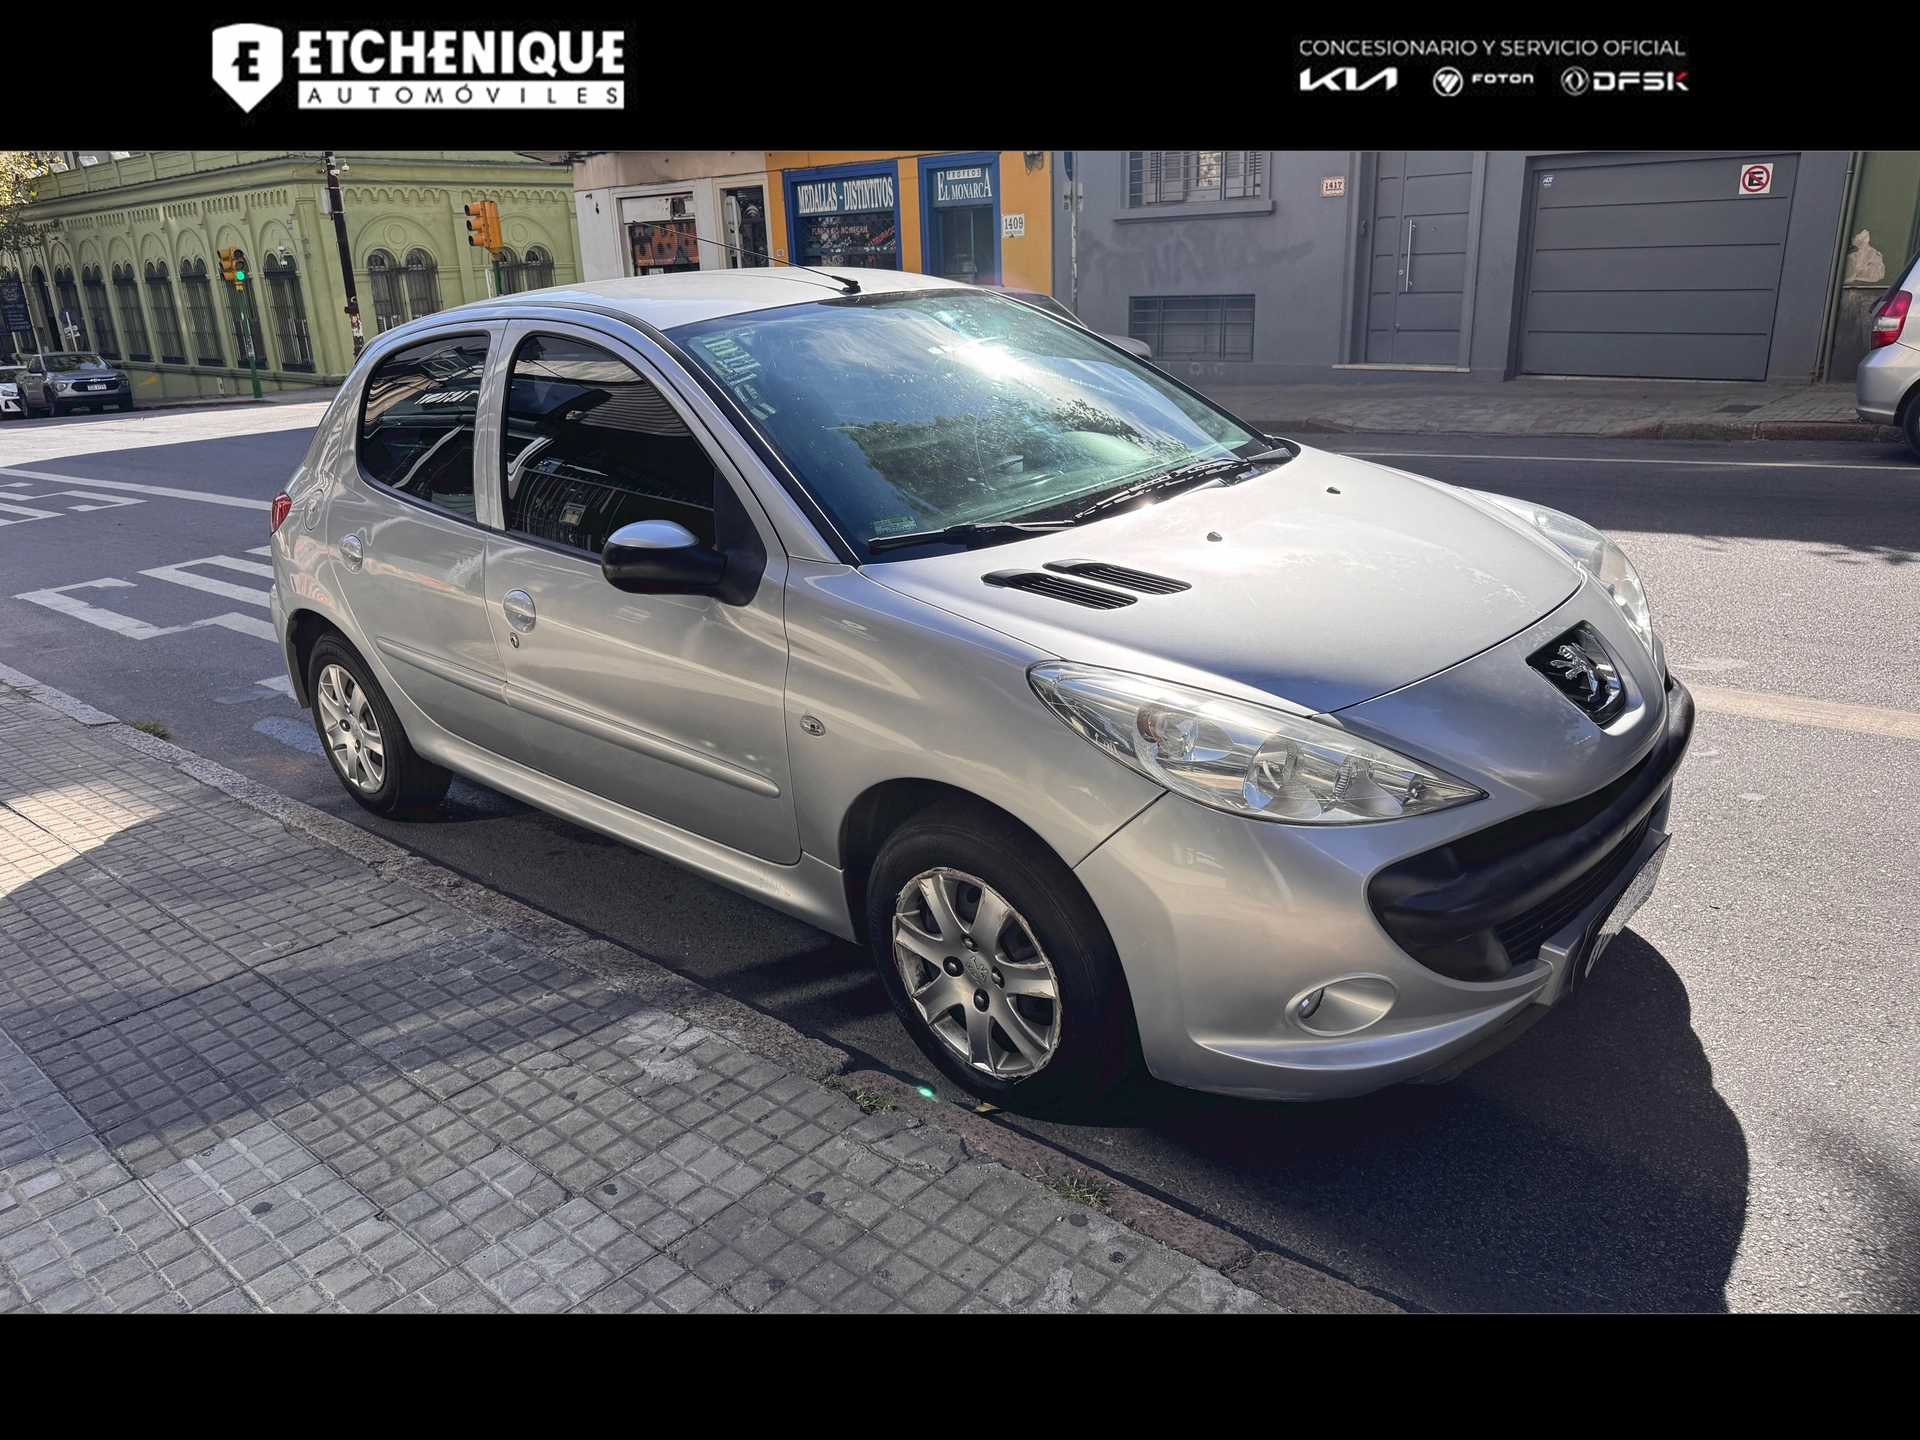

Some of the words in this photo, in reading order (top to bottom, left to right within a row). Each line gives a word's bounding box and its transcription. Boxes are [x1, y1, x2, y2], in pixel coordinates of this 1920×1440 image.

[937, 171, 950, 201] EL
[951, 167, 993, 200] MONARCA
[948, 169, 981, 178] TROFEOS
[797, 182, 838, 214] MEDALLAS
[842, 176, 894, 211] DISTINTIVOS
[1004, 217, 1024, 230] 1409
